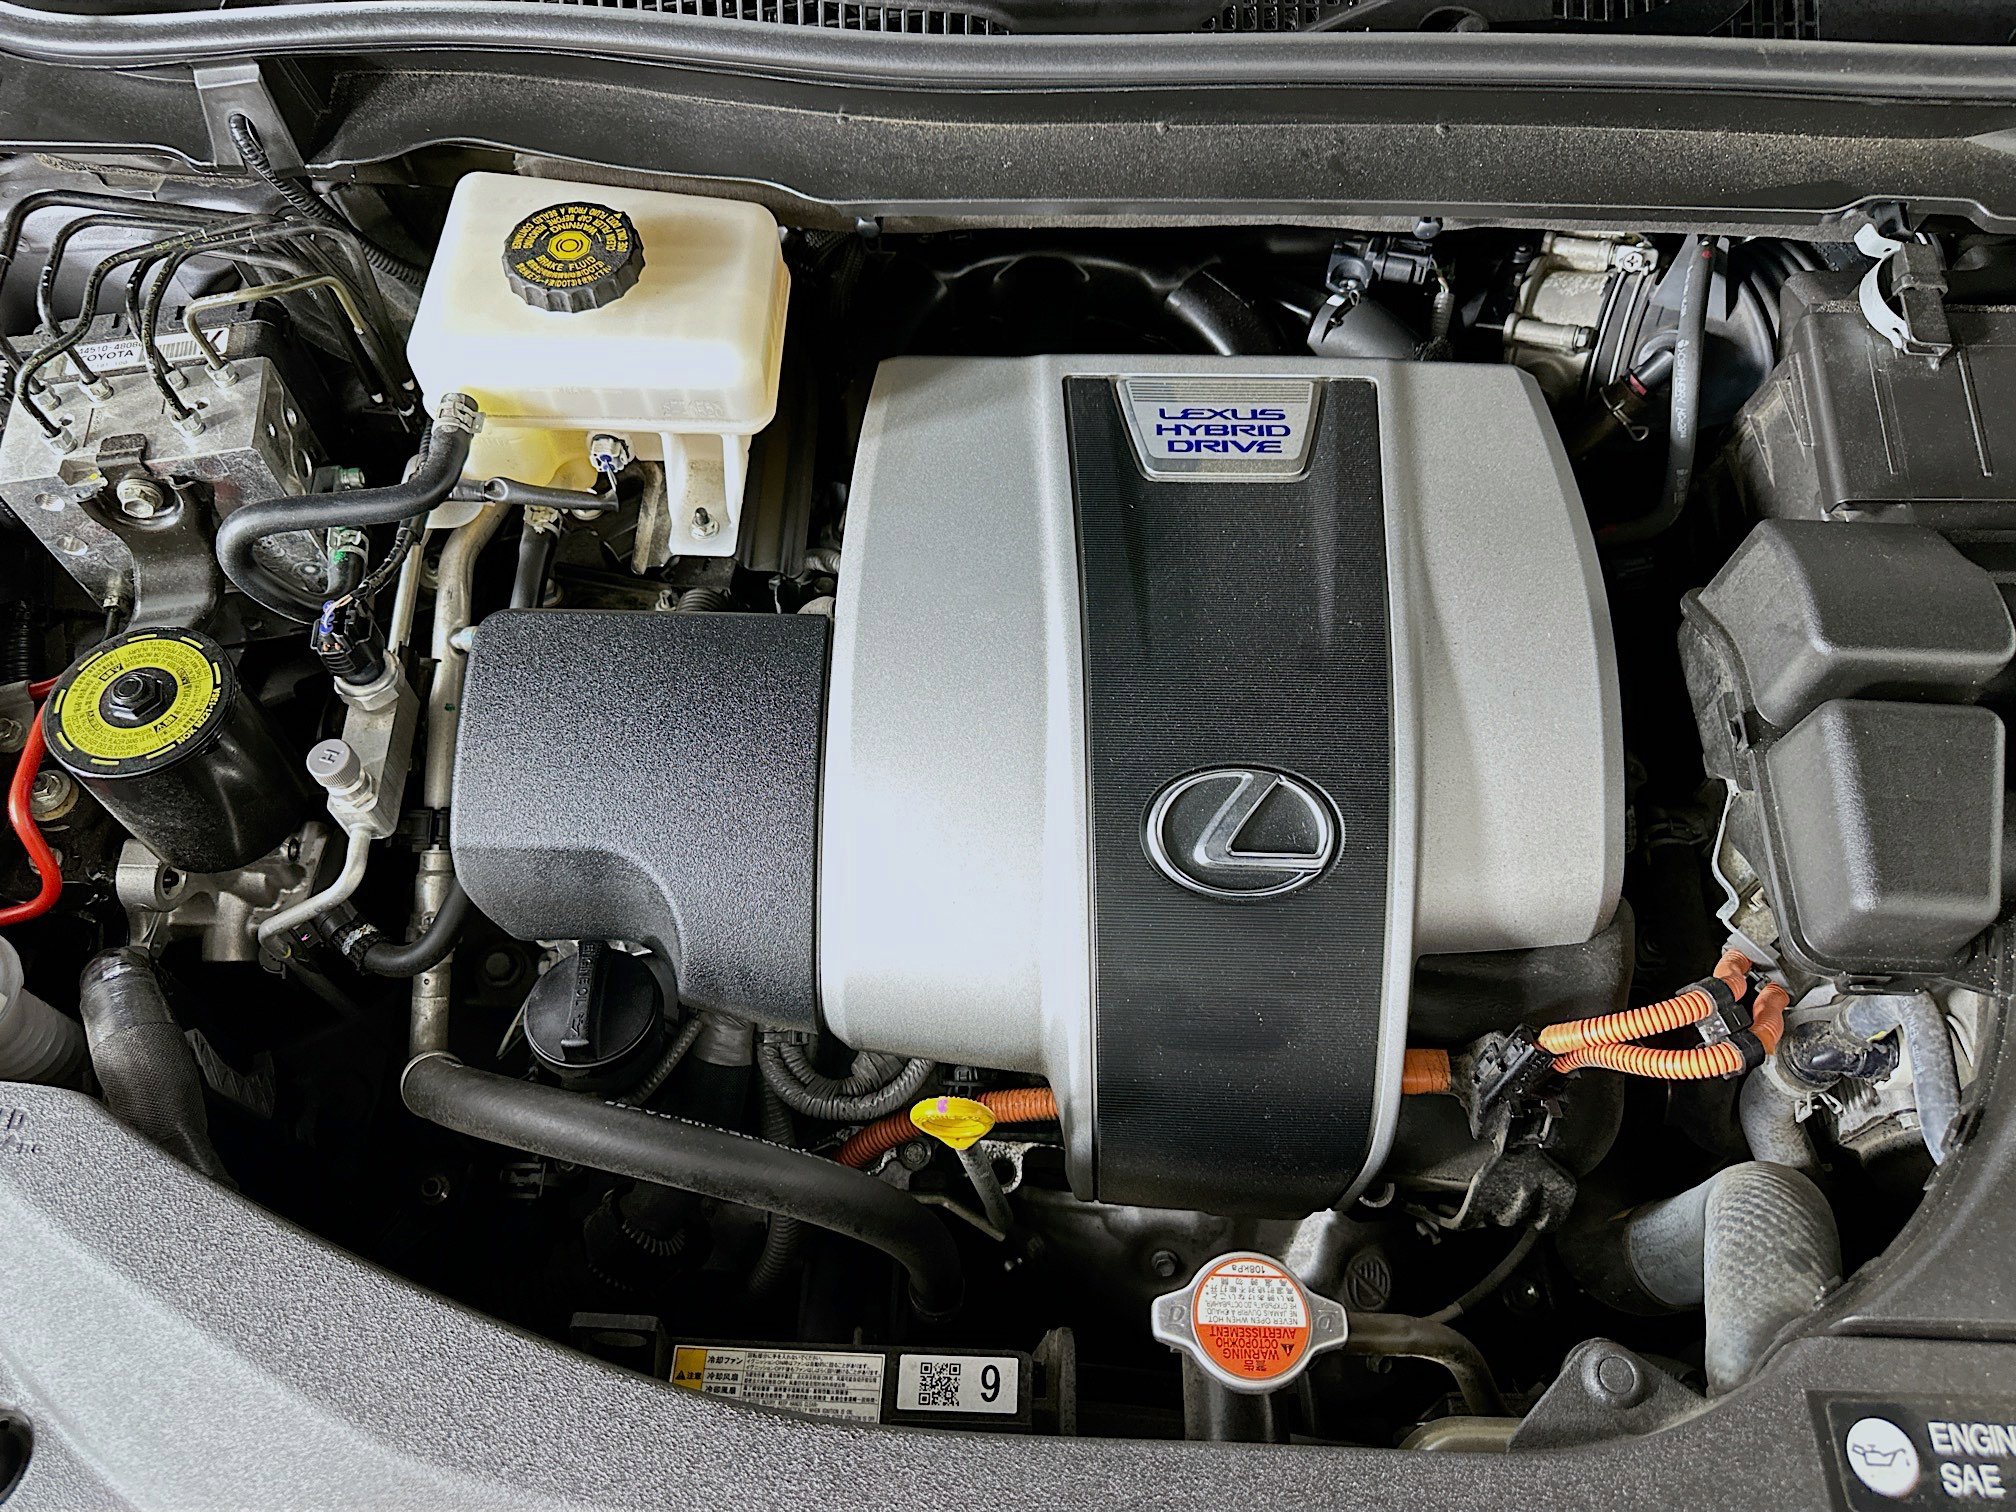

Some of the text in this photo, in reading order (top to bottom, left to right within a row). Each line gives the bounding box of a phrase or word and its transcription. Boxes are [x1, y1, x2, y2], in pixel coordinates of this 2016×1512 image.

[568, 206, 588, 214] FROM
[588, 208, 608, 218] FLUID
[532, 209, 558, 224] SEALED
[546, 214, 575, 228] BEFORE
[577, 214, 593, 222] CAP
[548, 221, 598, 236] WARNING
[536, 254, 564, 271] BRAKE
[568, 256, 596, 271] FLUID
[1158, 408, 1286, 420] LEXUS
[1156, 424, 1290, 436] HYBRID
[1168, 440, 1282, 454] DRIVE
[175, 727, 198, 744] NOK
[319, 749, 341, 764] H
[1232, 1264, 1266, 1274] 108kPa
[1250, 1316, 1271, 1324] OPEN
[1274, 1317, 1298, 1325] NEVER
[1210, 1327, 1296, 1338] AVERTISSEMENT
[1216, 1337, 1278, 1350] ОСТОРОЖНО
[707, 1355, 744, 1365] 冷却ファン
[1223, 1348, 1280, 1360] WARNING
[1244, 1360, 1267, 1372] 警告
[980, 1364, 1000, 1402] 9
[1940, 1462, 2006, 1499] SAE
